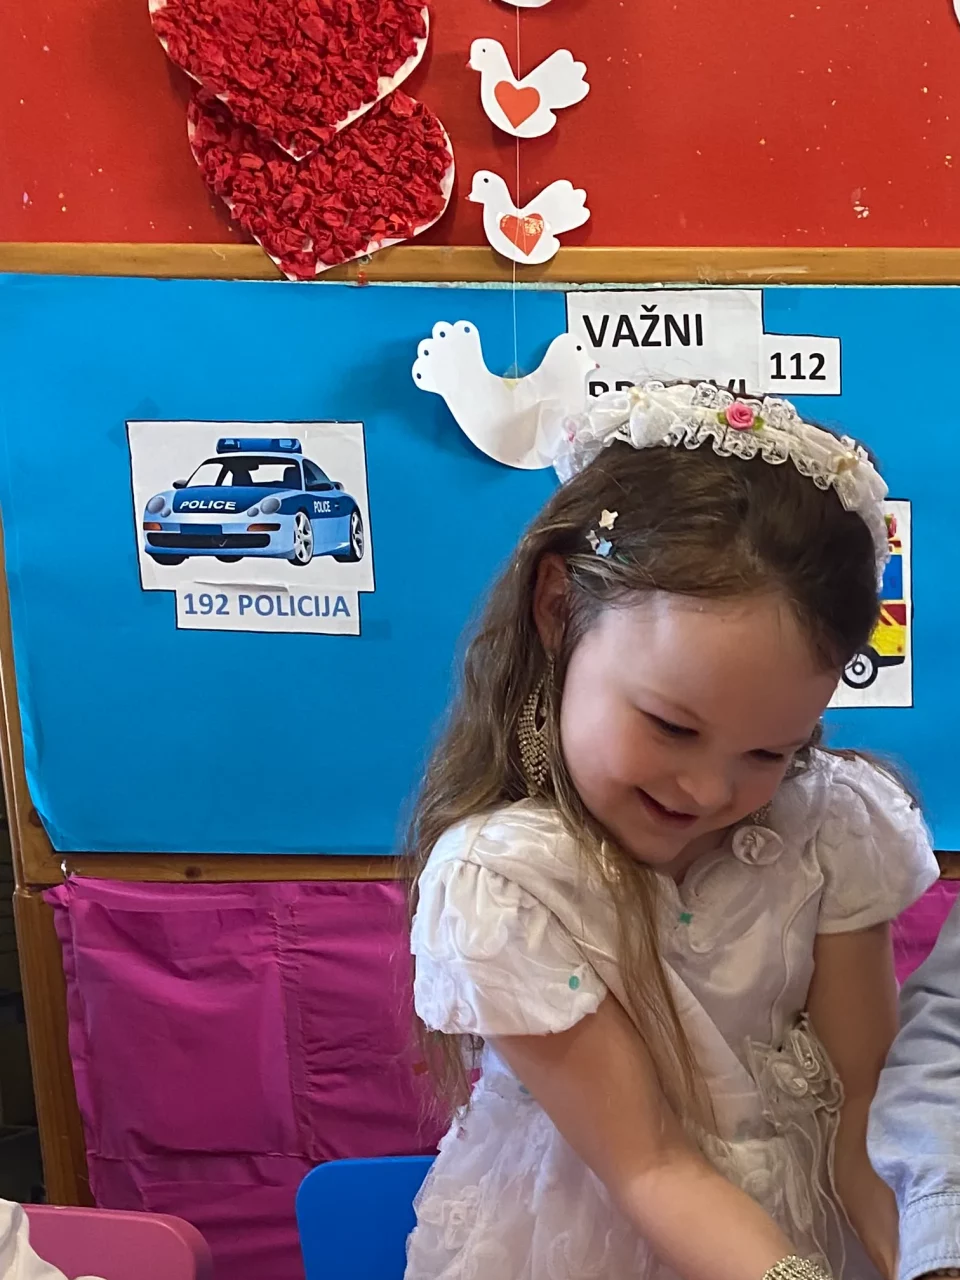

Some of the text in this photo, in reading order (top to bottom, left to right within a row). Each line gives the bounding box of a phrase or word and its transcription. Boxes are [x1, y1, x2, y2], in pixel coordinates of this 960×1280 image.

[582, 304, 703, 347] VAŽNI
[770, 352, 826, 380] 112
[180, 500, 236, 510] POLICE
[313, 500, 331, 513] POLICE
[184, 593, 351, 617] 192 POLICIJA
